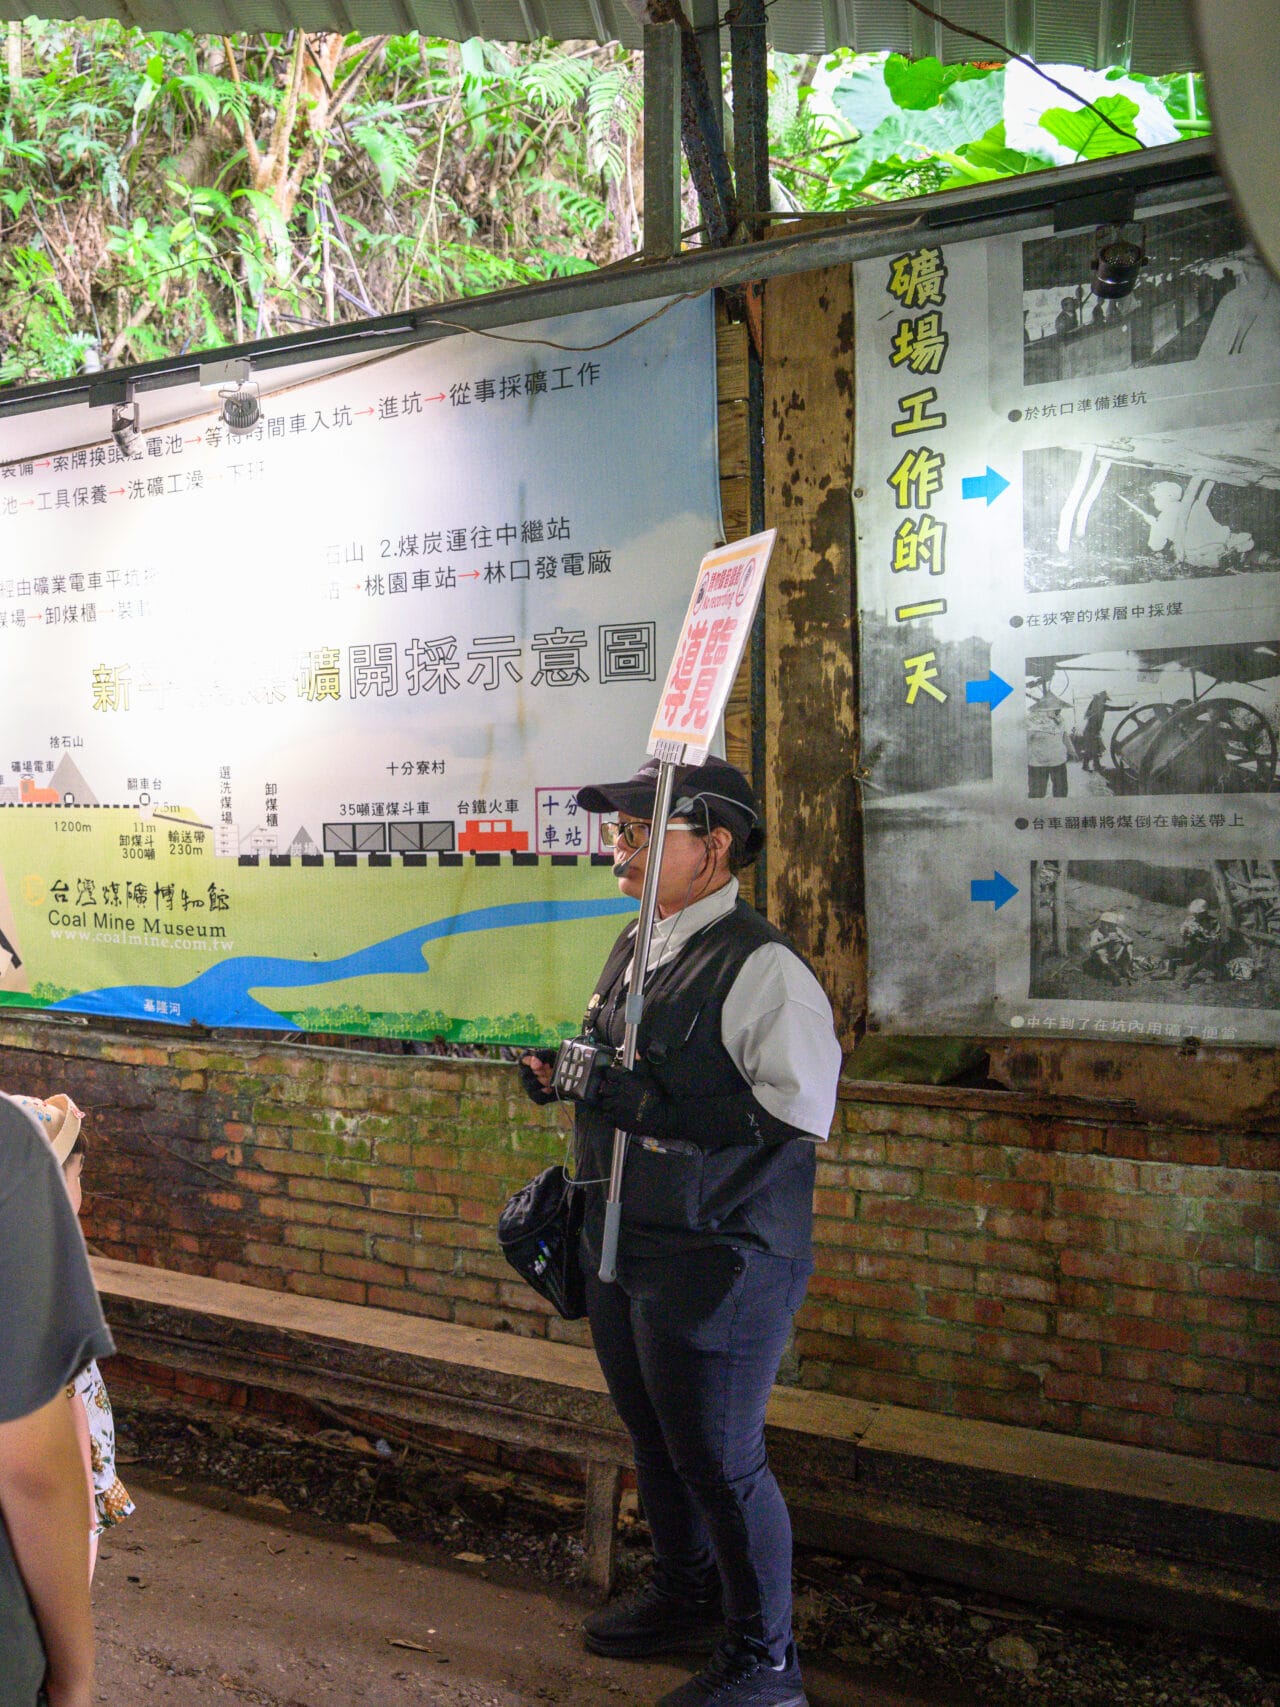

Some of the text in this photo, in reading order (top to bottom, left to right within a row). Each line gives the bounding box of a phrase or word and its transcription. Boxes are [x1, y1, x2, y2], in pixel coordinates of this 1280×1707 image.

[378, 390, 423, 421] 進坑
[449, 361, 602, 407] 從事採礦工作
[1024, 390, 1148, 421] 於坑口準備進坑
[890, 245, 947, 705] 礦場工作的一天
[37, 485, 108, 512] 工具保養
[128, 470, 205, 500] 洗礦工澡
[380, 516, 571, 559] 2.煤炭運往中繼站
[45, 602, 97, 626] 卸煤櫃
[364, 566, 457, 597] 桃園車站
[484, 549, 613, 585] 林口發電廠
[1025, 601, 1184, 628] 在狹窄的煤層中採煤
[91, 619, 658, 713] 新礦開採示意圖
[49, 736, 84, 749] 捨石山
[11, 760, 55, 773] 礦場電車
[386, 759, 446, 777] 十分寮村
[219, 765, 233, 825] 選洗煤場
[264, 782, 279, 827] 卸煤櫃
[457, 799, 520, 816] 台鐵火車
[54, 821, 93, 833] 1200m
[133, 822, 157, 833] 11m
[1032, 812, 1245, 830] 台車翻轉將煤倒在輸送帶上
[119, 834, 155, 848] 卸煤斗
[168, 830, 206, 844] 輸送帶
[542, 824, 582, 849] 車站
[169, 844, 204, 856] 230m
[48, 909, 227, 938] Coal Mine Museum
[50, 928, 234, 950] www.coalmine.com.tw
[143, 998, 181, 1017] 基隆河
